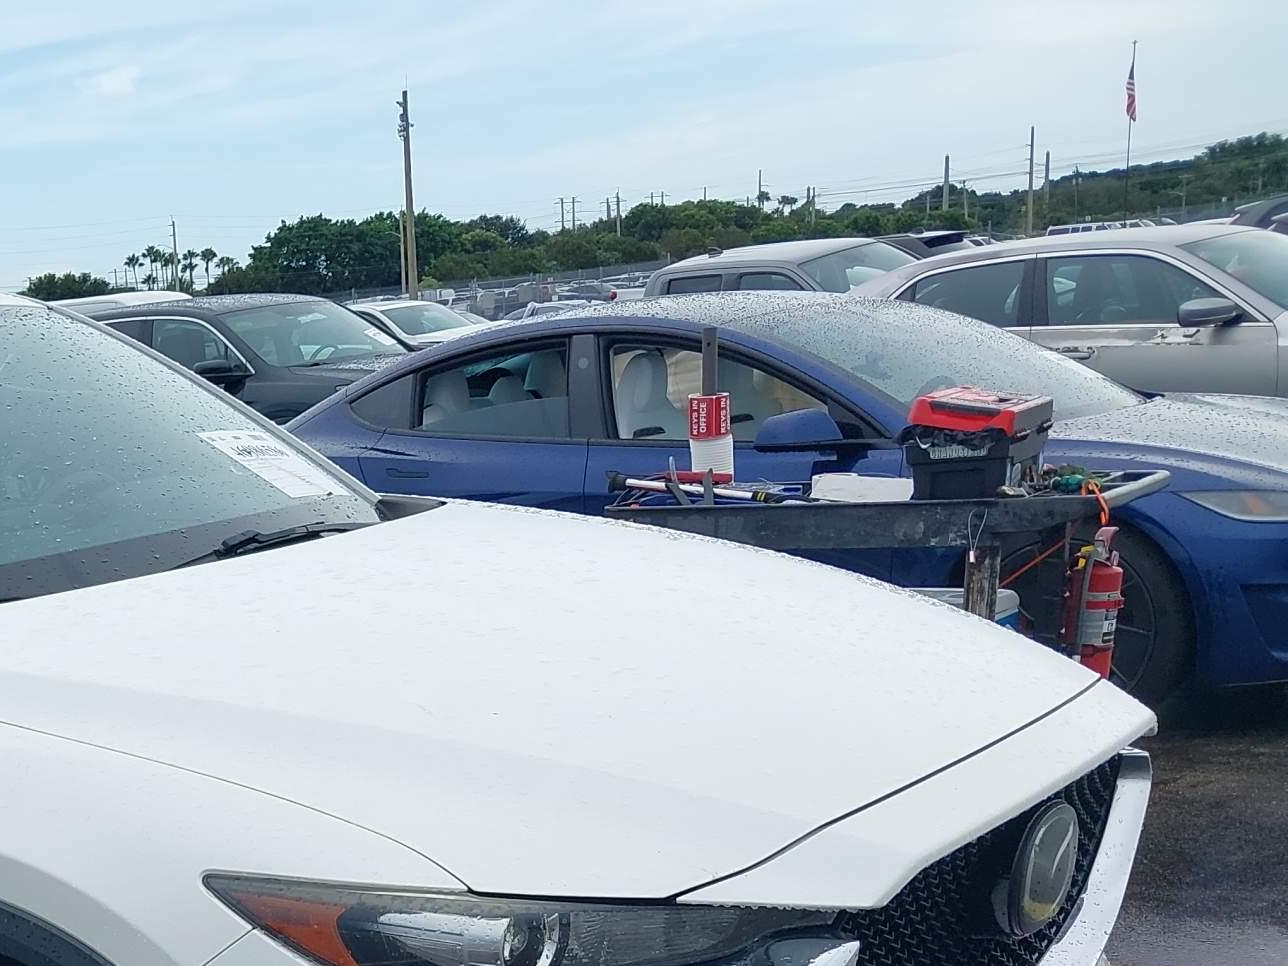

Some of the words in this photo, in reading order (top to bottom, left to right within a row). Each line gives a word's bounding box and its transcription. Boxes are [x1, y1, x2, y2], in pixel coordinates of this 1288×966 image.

[692, 400, 698, 410] IN
[720, 398, 726, 408] IN
[699, 402, 707, 433] OFFICE
